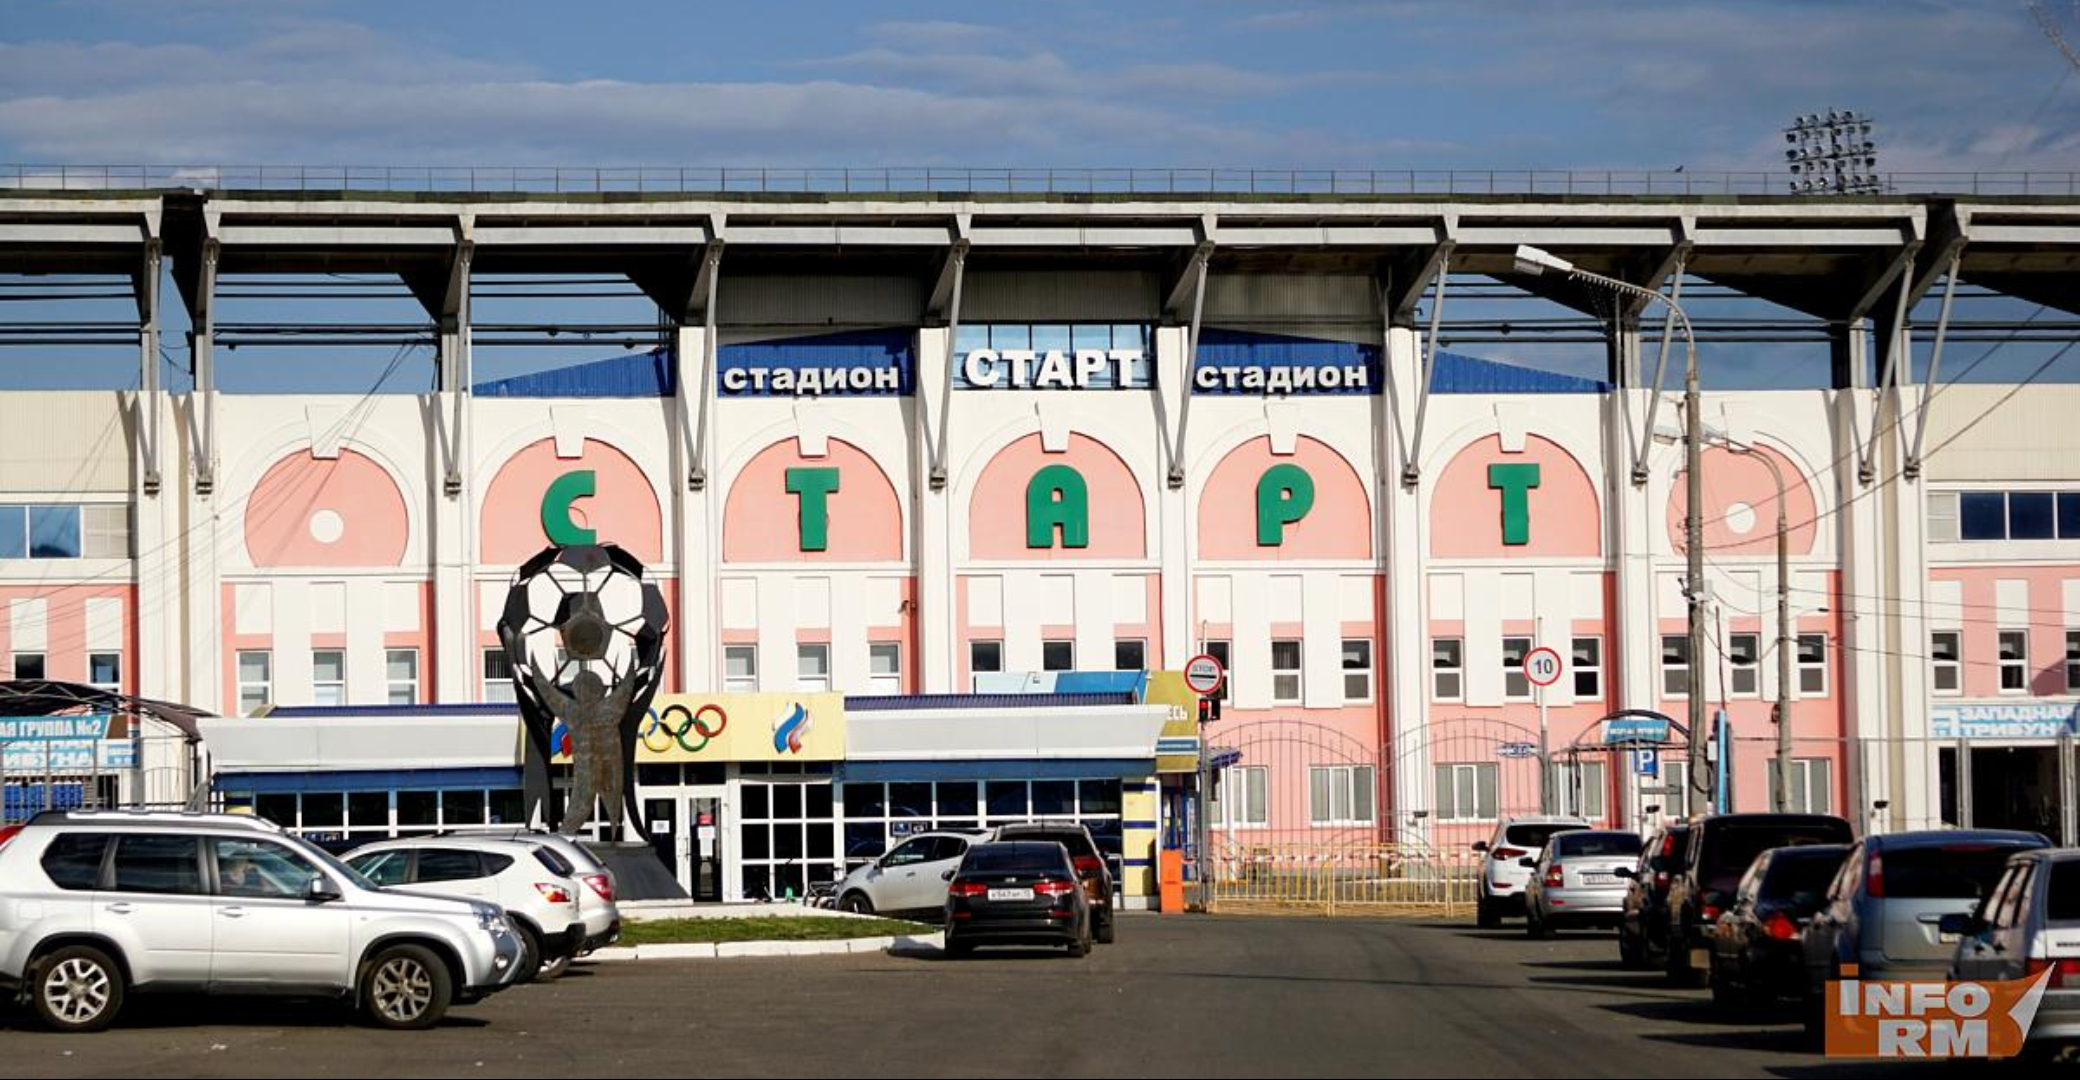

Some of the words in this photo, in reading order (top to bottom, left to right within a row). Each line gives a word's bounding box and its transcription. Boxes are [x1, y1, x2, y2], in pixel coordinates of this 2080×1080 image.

[965, 349, 1142, 387] СТАРТ
[724, 367, 898, 394] стадион
[1196, 366, 1367, 392] стадион
[1191, 664, 1216, 672] STOP
[1534, 659, 1553, 674] 10
[20, 721, 74, 736] ГРУППА
[76, 721, 102, 735] №2
[1960, 722, 2070, 736] ТРИБУН
